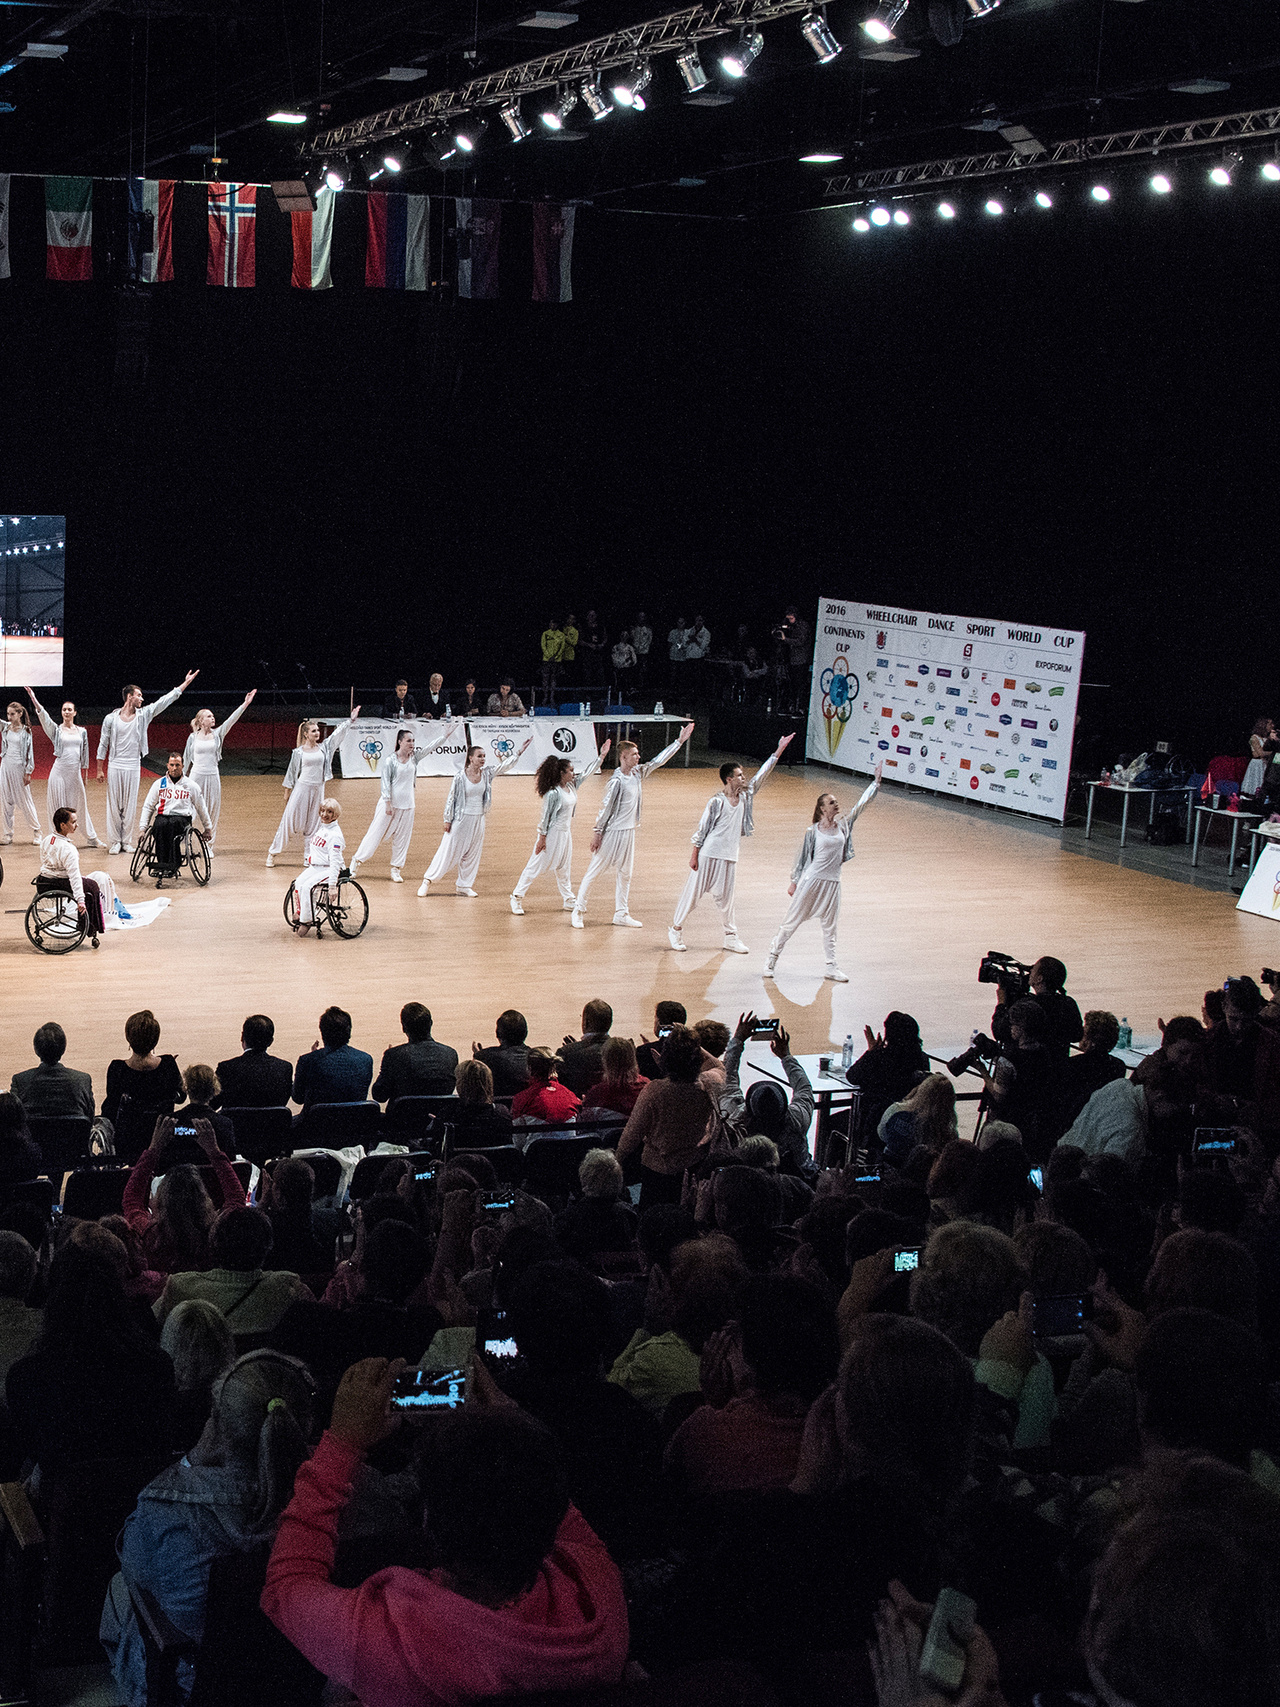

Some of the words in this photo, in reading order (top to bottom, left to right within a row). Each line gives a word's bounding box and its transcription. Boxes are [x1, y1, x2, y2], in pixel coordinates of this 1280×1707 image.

[823, 625, 865, 640] CONTINENTS
[825, 603, 847, 616] 2016
[866, 609, 918, 627] WHEELCHAIR
[928, 618, 955, 632] DANCE
[966, 623, 996, 638] SPORT
[1007, 628, 1042, 644] WORLD
[1053, 635, 1075, 649] CUP
[835, 642, 850, 653] CUP
[1035, 660, 1073, 673] EXPOFORUM
